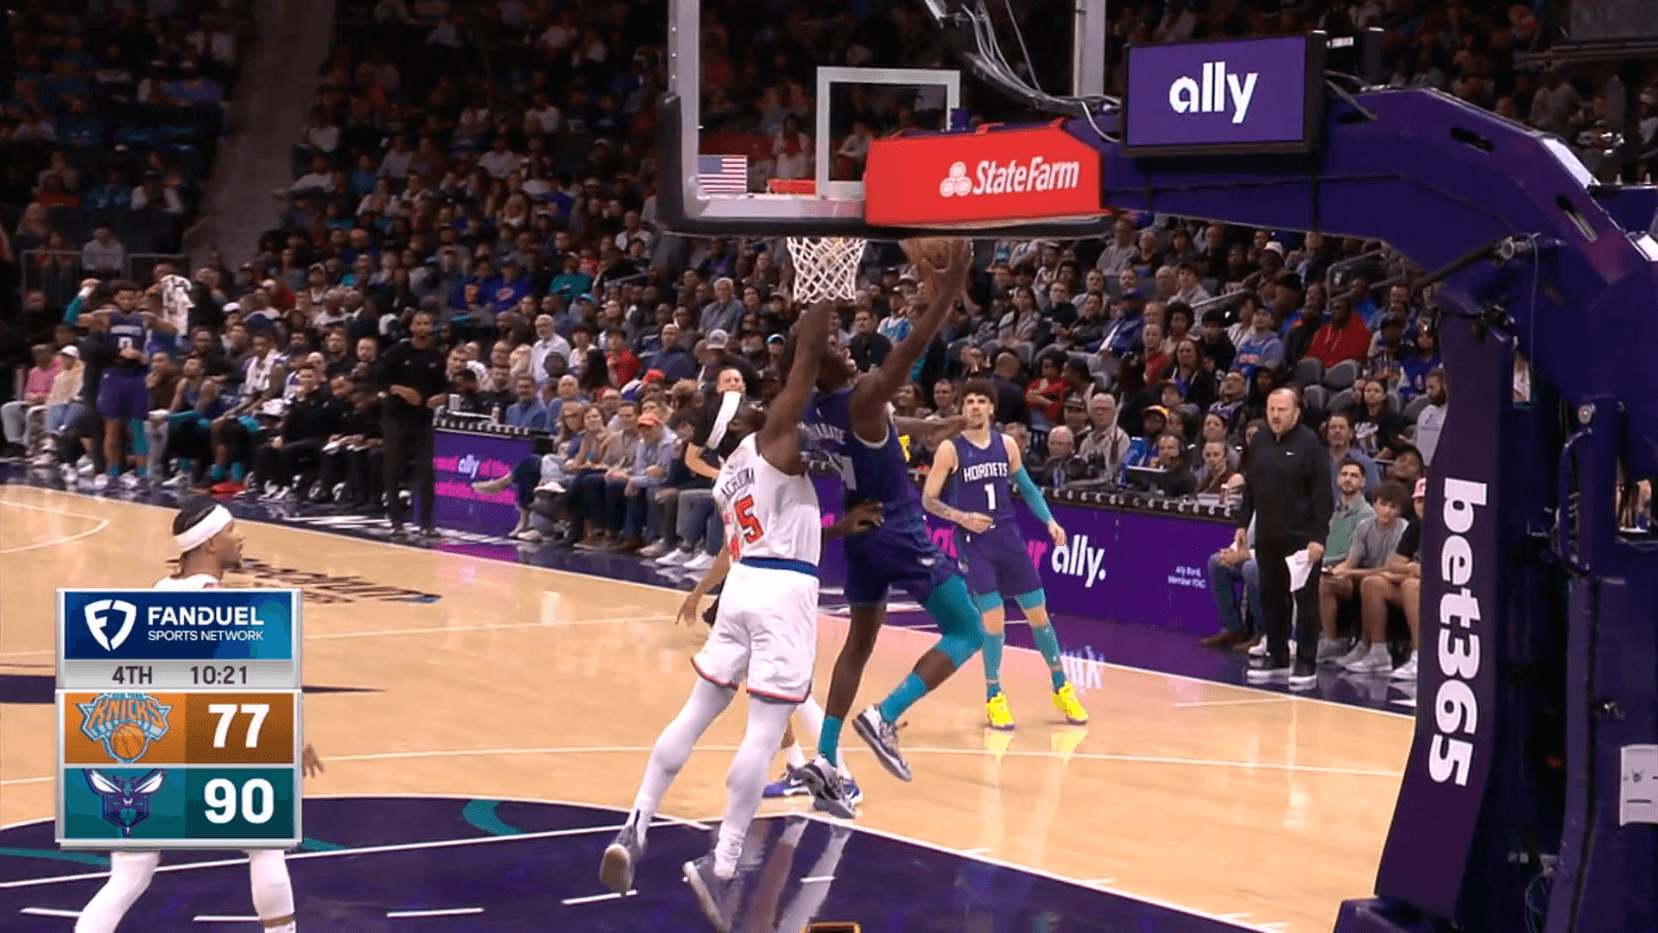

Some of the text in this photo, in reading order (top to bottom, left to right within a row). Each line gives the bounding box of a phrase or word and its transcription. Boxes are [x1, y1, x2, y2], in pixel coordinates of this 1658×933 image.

[1169, 61, 1259, 124] ally
[972, 156, 1081, 196] StateFarm
[963, 462, 1008, 483] HORNETS
[984, 483, 997, 510] 1
[735, 494, 764, 544] 5
[1051, 535, 1107, 588] ally.
[1428, 477, 1488, 786] bet365
